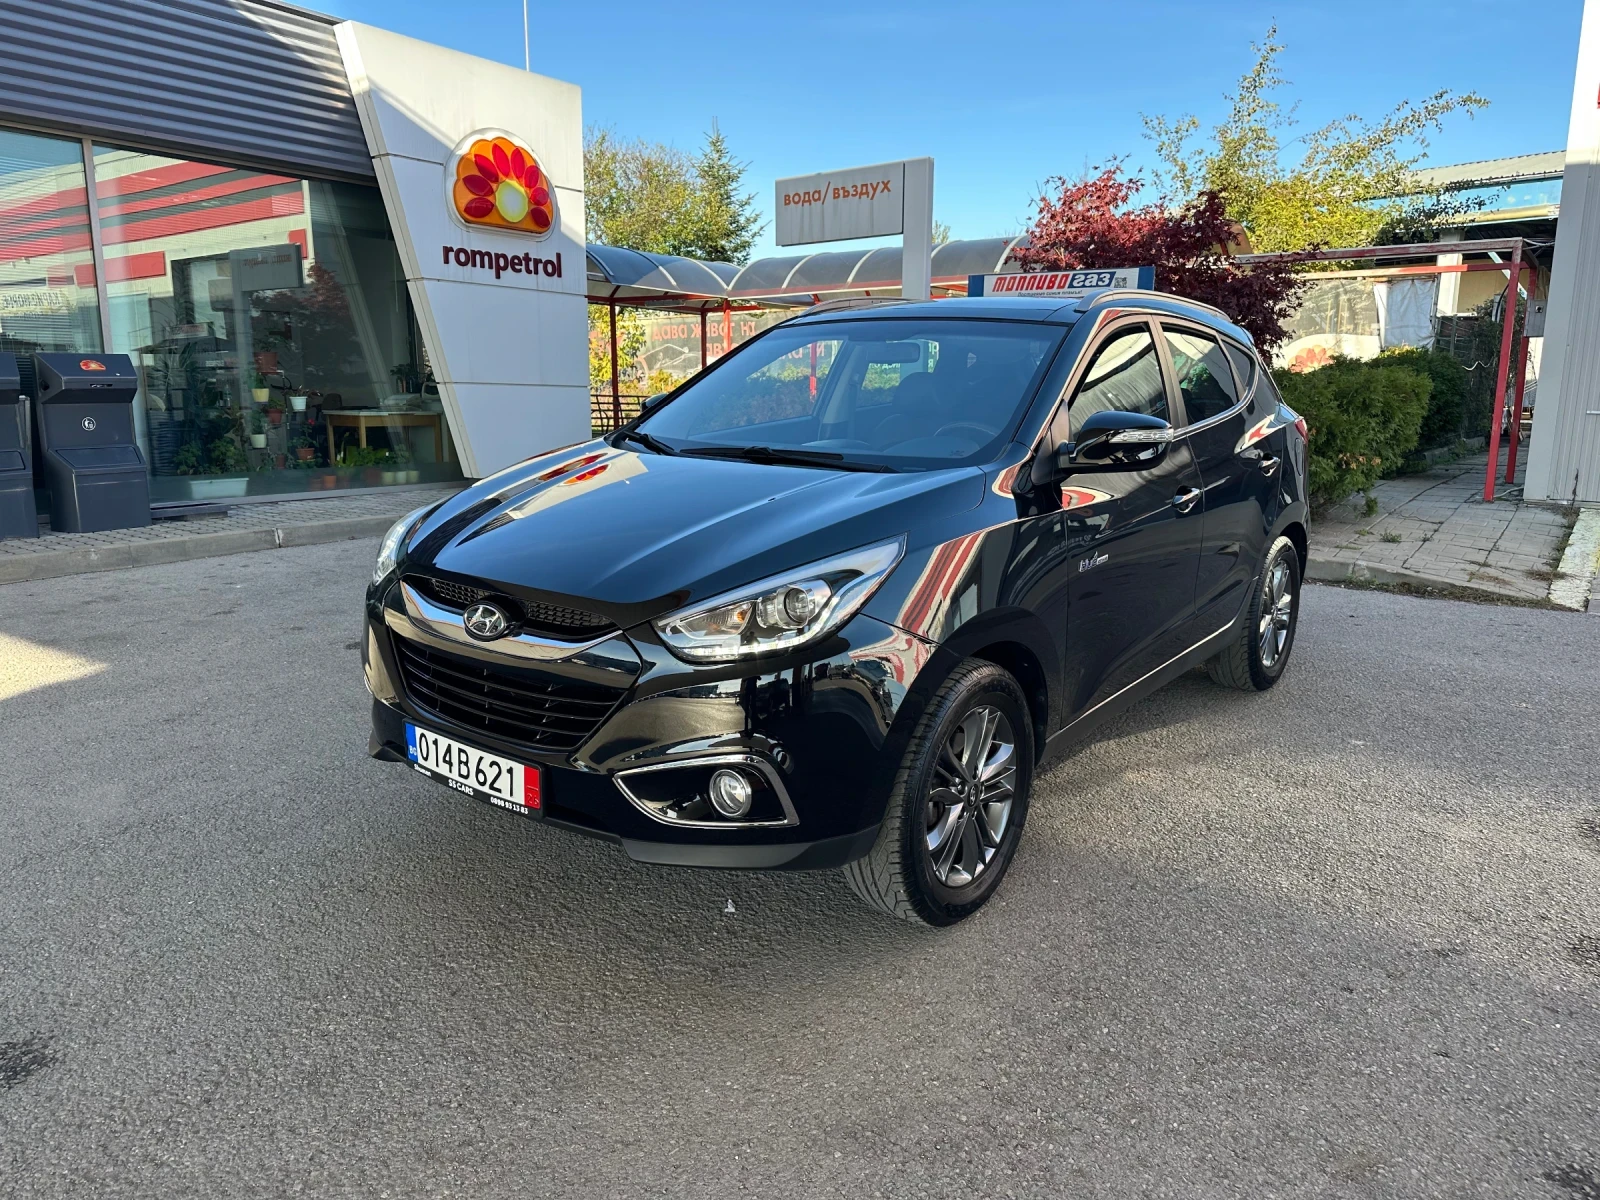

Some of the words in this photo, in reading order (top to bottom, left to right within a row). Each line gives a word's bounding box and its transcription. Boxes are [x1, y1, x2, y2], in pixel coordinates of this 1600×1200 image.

[783, 179, 892, 207] вода/въздух
[442, 245, 563, 280] rompetrol
[651, 324, 688, 341] дава
[740, 321, 756, 336] на
[456, 782, 474, 796] CARS
